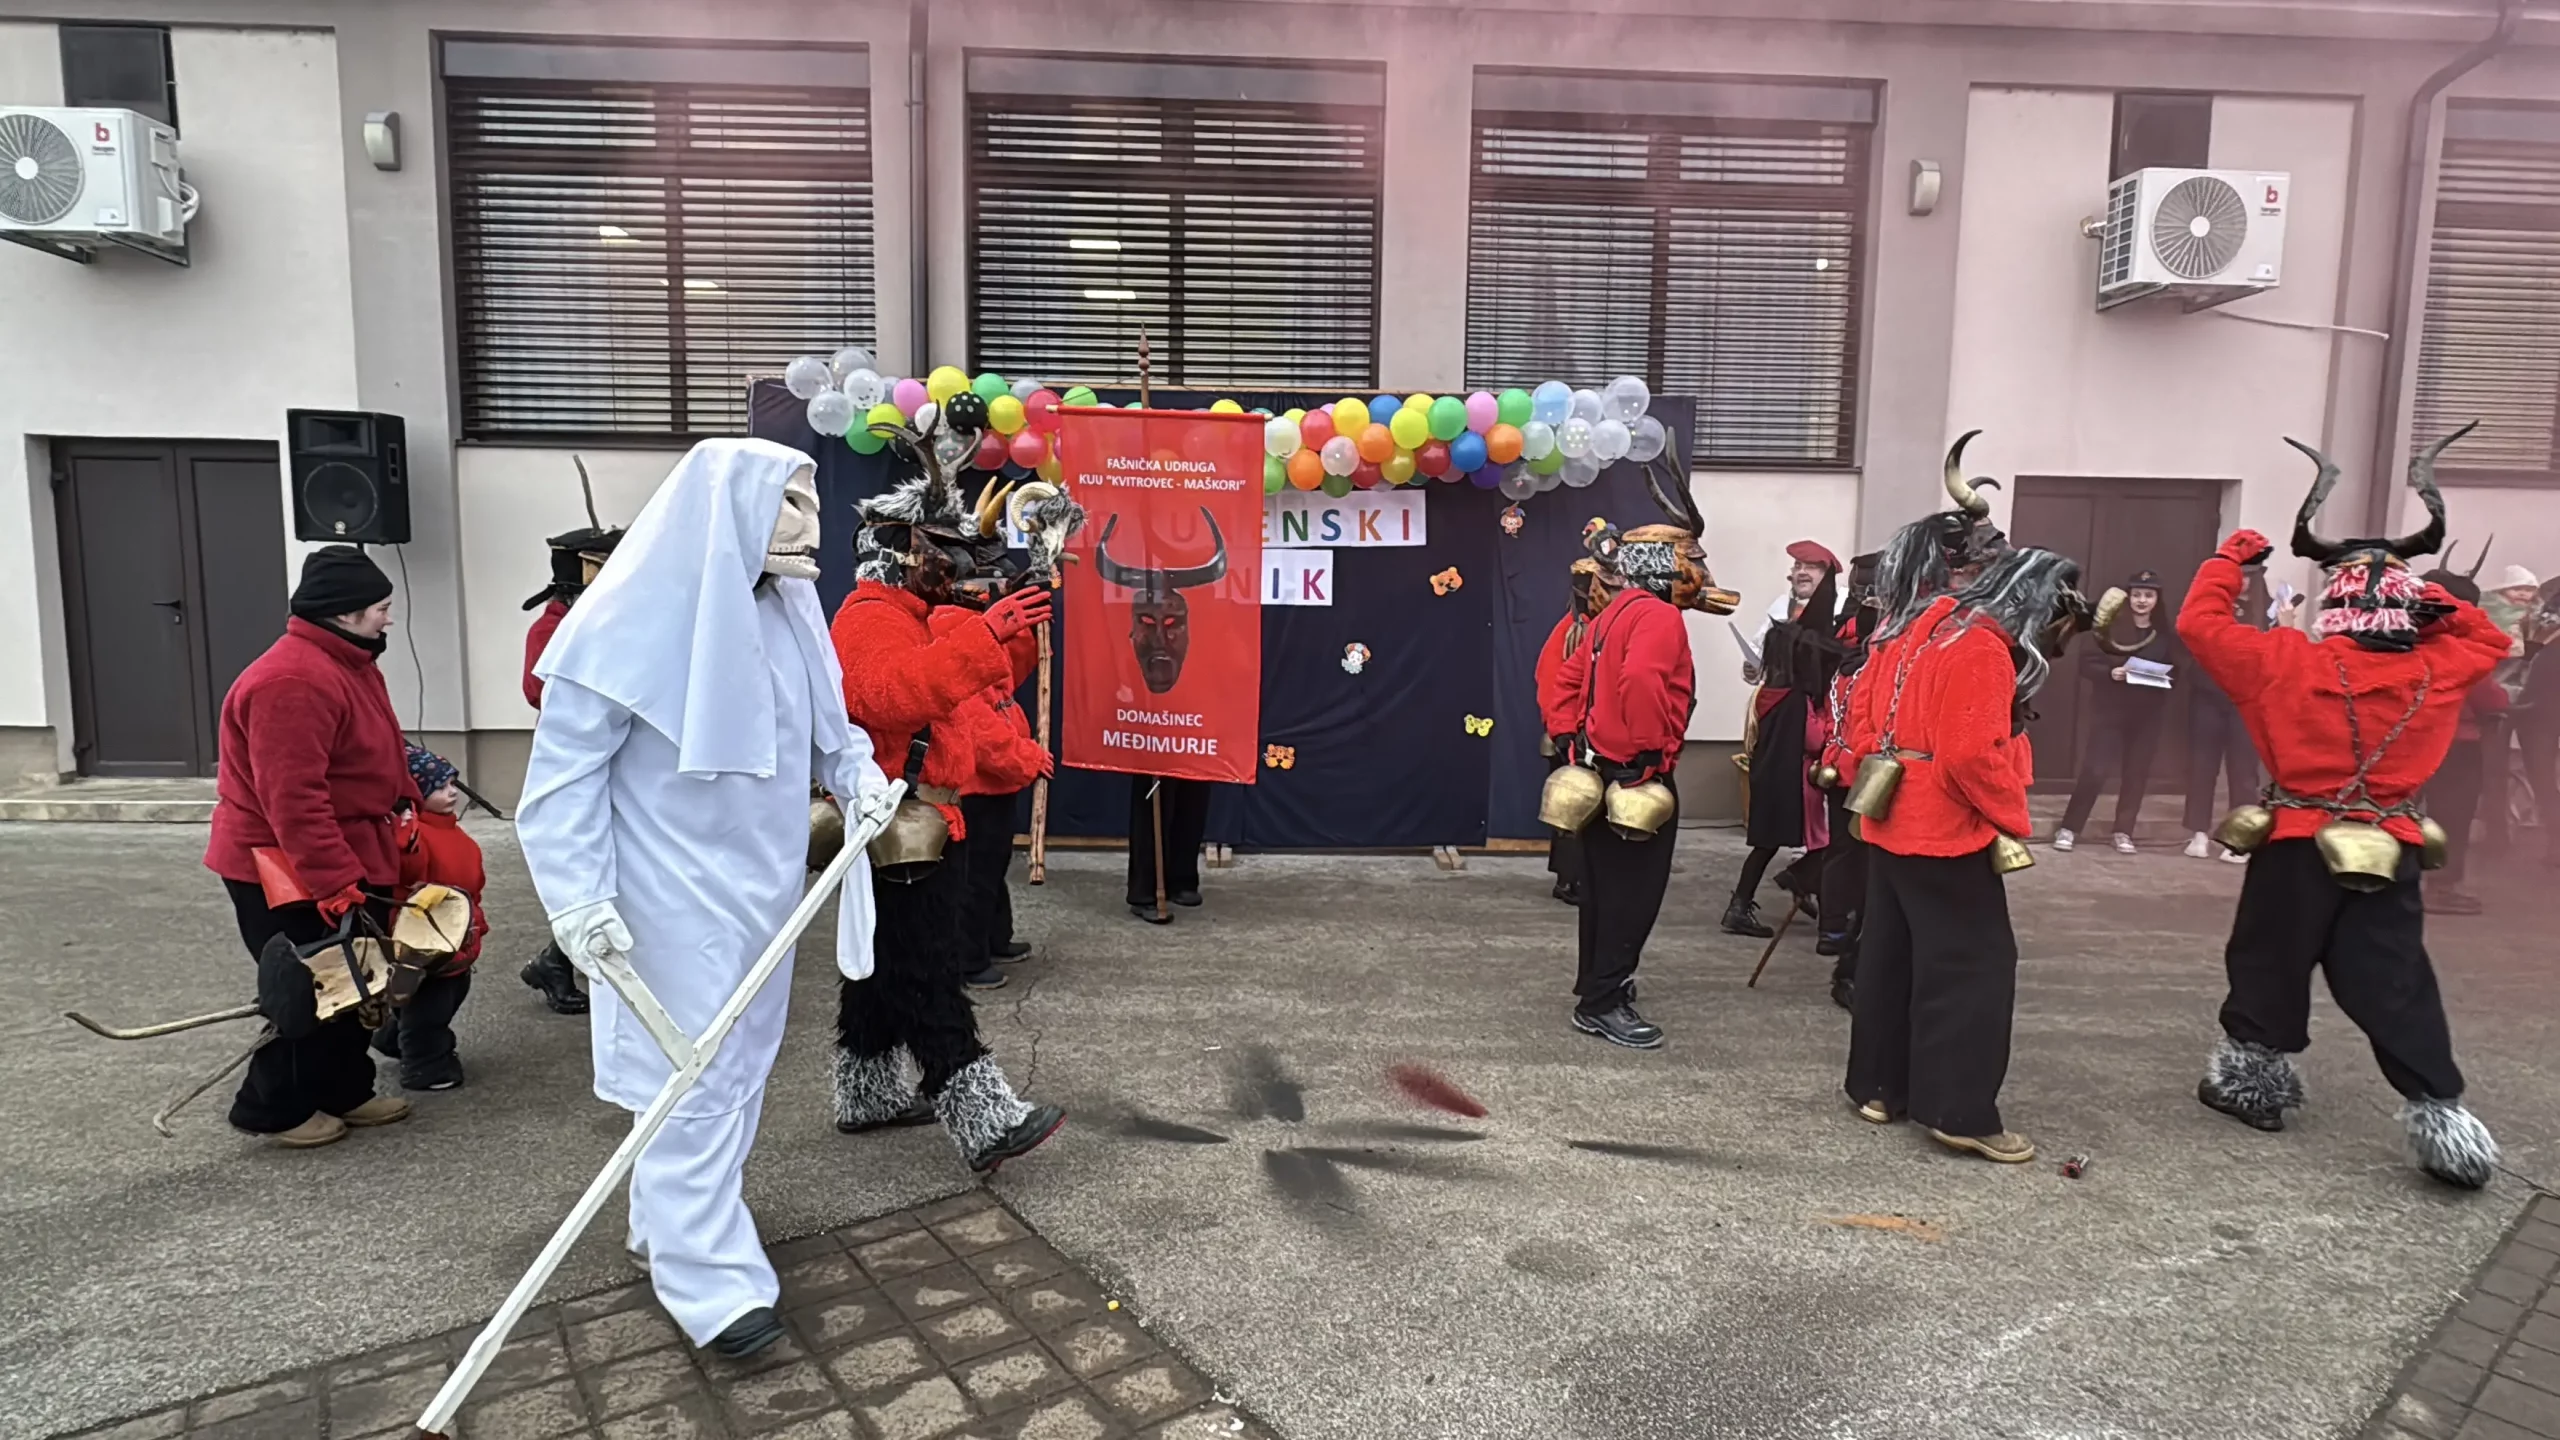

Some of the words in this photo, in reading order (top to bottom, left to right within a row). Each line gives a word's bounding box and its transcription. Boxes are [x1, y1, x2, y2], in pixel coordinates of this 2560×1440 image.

[1107, 456, 1161, 472] FAŠNIČKA
[1164, 460, 1216, 473] UDRUGA
[1079, 473, 1103, 486] KUU
[1117, 708, 1203, 727] DOMAŠINEC
[1103, 729, 1218, 756] MEĐIMURJE
